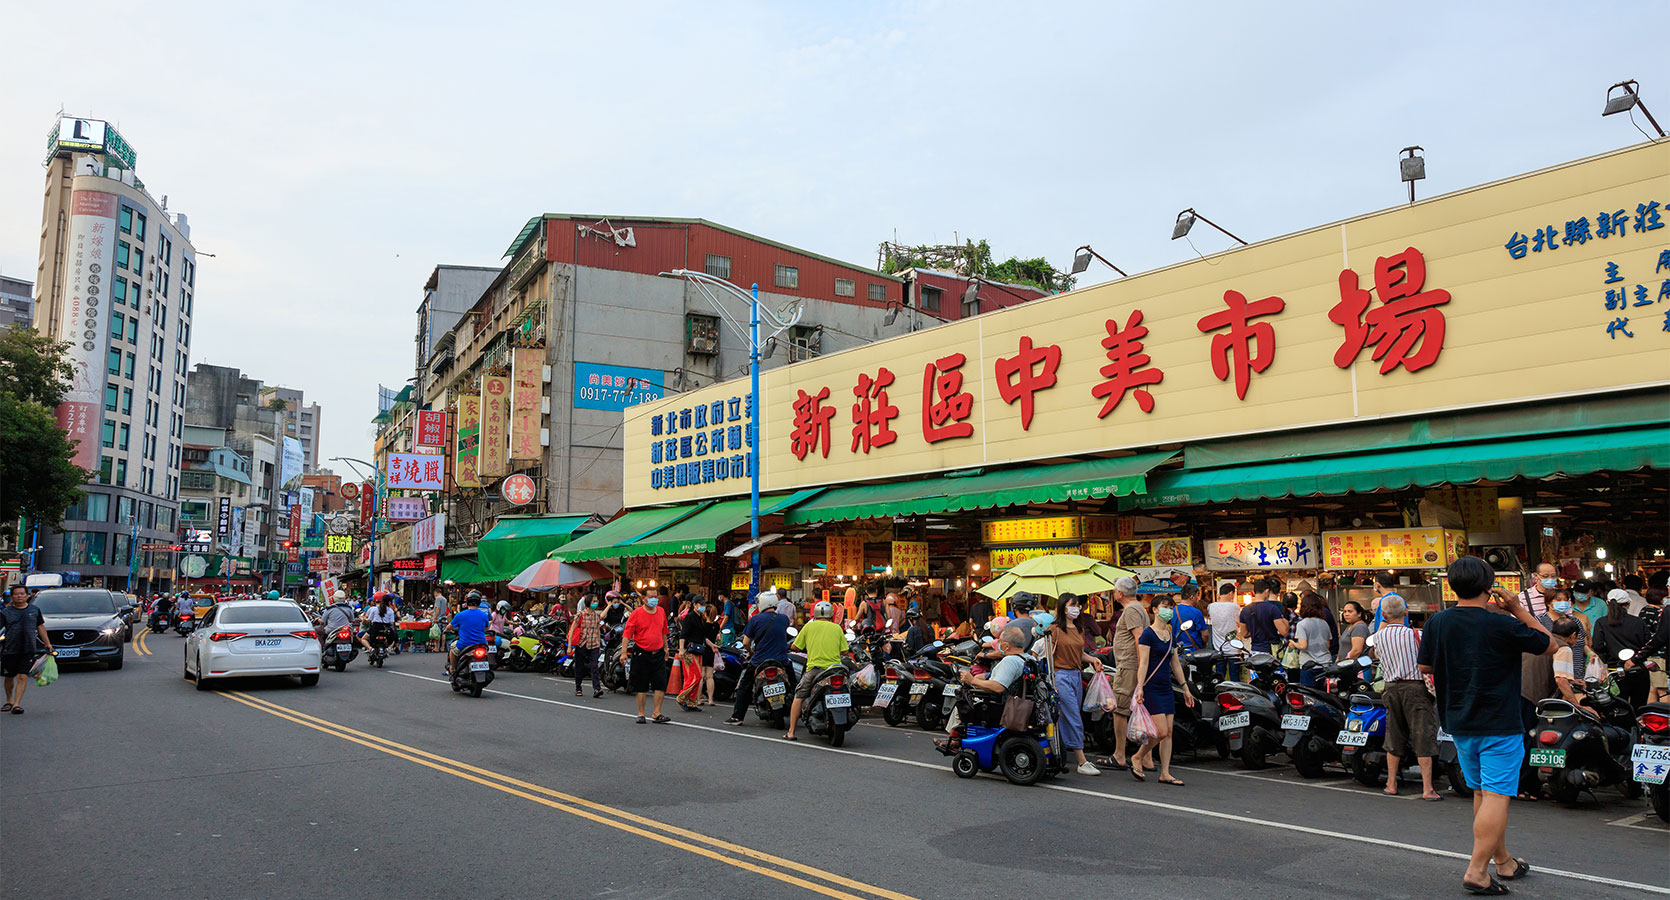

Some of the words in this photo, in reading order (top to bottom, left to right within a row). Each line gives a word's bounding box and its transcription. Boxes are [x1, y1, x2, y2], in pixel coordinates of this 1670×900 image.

[1505, 201, 1670, 260] 台北縣新莊
[790, 246, 1452, 461] 新莊區中美市場
[424, 413, 440, 444] 胡椒餅
[389, 456, 402, 485] 吉祥
[505, 483, 533, 500] 素食
[1253, 538, 1311, 567] 生魚片
[1328, 536, 1343, 567] 鴨肉麵
